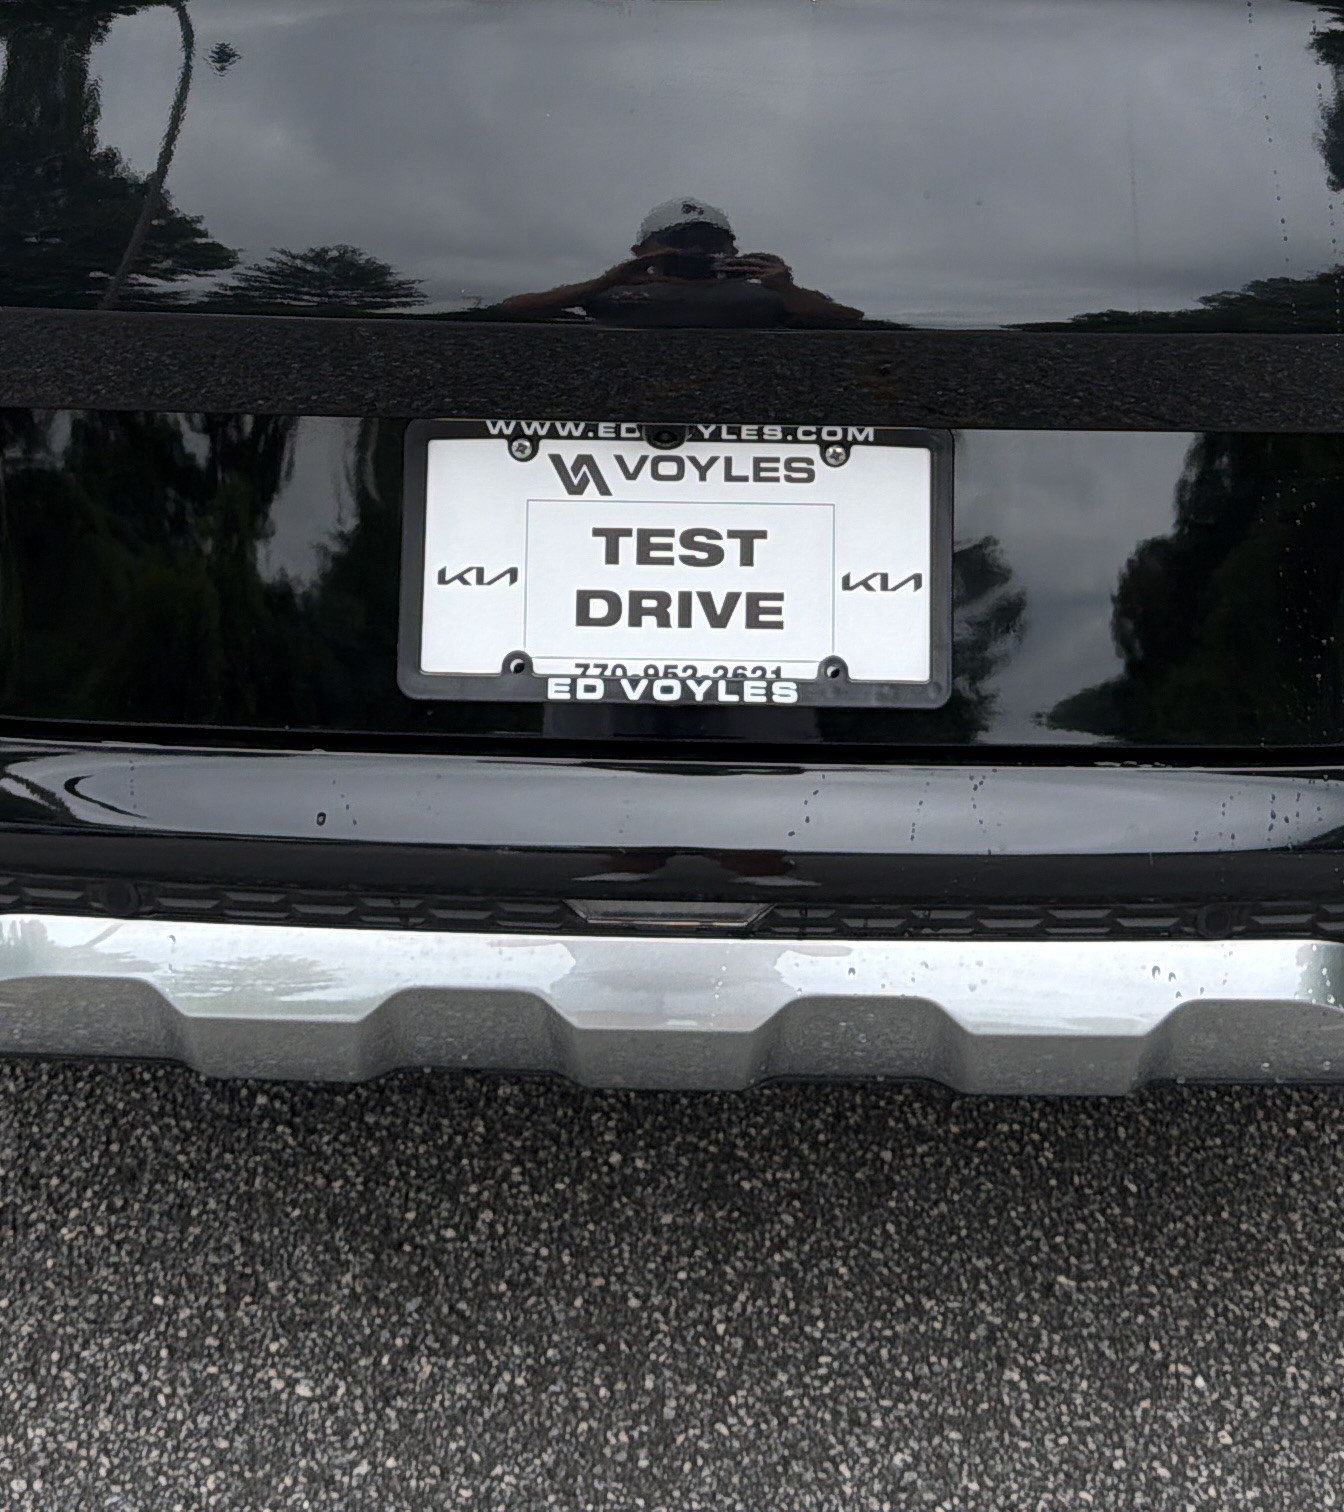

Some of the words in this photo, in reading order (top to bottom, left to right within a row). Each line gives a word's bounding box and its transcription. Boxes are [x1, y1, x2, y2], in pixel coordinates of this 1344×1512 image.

[485, 419, 876, 443] WWW.EDYLES.COM
[613, 453, 816, 484] VOYLES
[592, 528, 767, 567] TEST
[437, 565, 519, 587] KIA
[841, 571, 923, 592] KIA
[575, 589, 784, 630] DRIVE
[547, 678, 605, 700] ED
[620, 678, 799, 704] VOYLES
